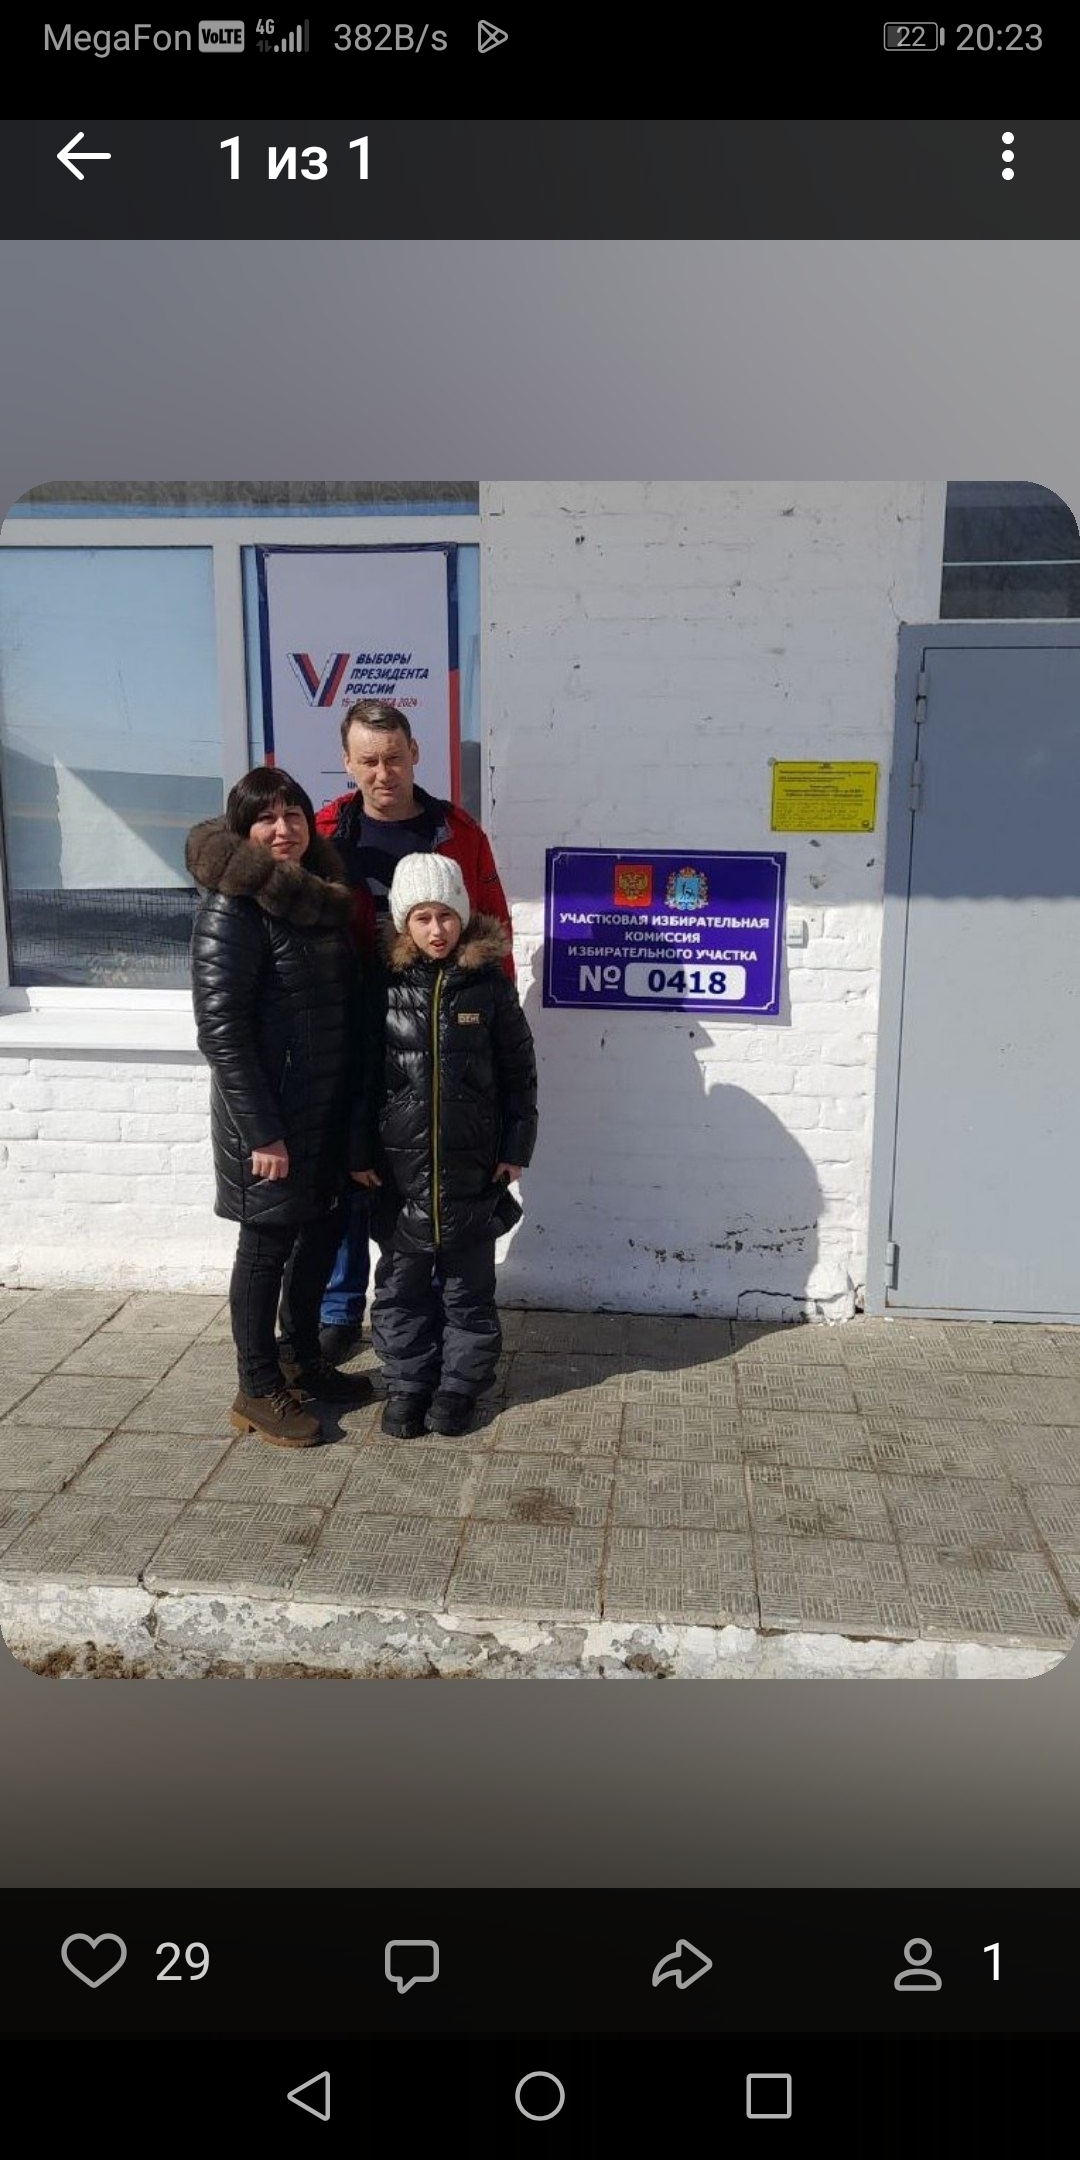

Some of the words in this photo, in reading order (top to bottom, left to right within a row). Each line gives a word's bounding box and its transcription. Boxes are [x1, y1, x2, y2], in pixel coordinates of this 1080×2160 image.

[355, 652, 412, 665] ВЫБОРЫ
[350, 667, 430, 681] ПРЕЗИДЕНТА
[344, 683, 396, 695] РОССИИ
[559, 912, 649, 926] УЧАСТКОВАЯ
[651, 915, 770, 929] ИЗБИРАТЕЛЬНАЯ
[624, 931, 701, 943] КОМИССИЯ
[568, 946, 692, 959] ИЗБИРАТЕЛЬНОГО
[696, 949, 758, 961] УЧАСТКА
[578, 965, 621, 992] №
[647, 969, 727, 994] 0418
